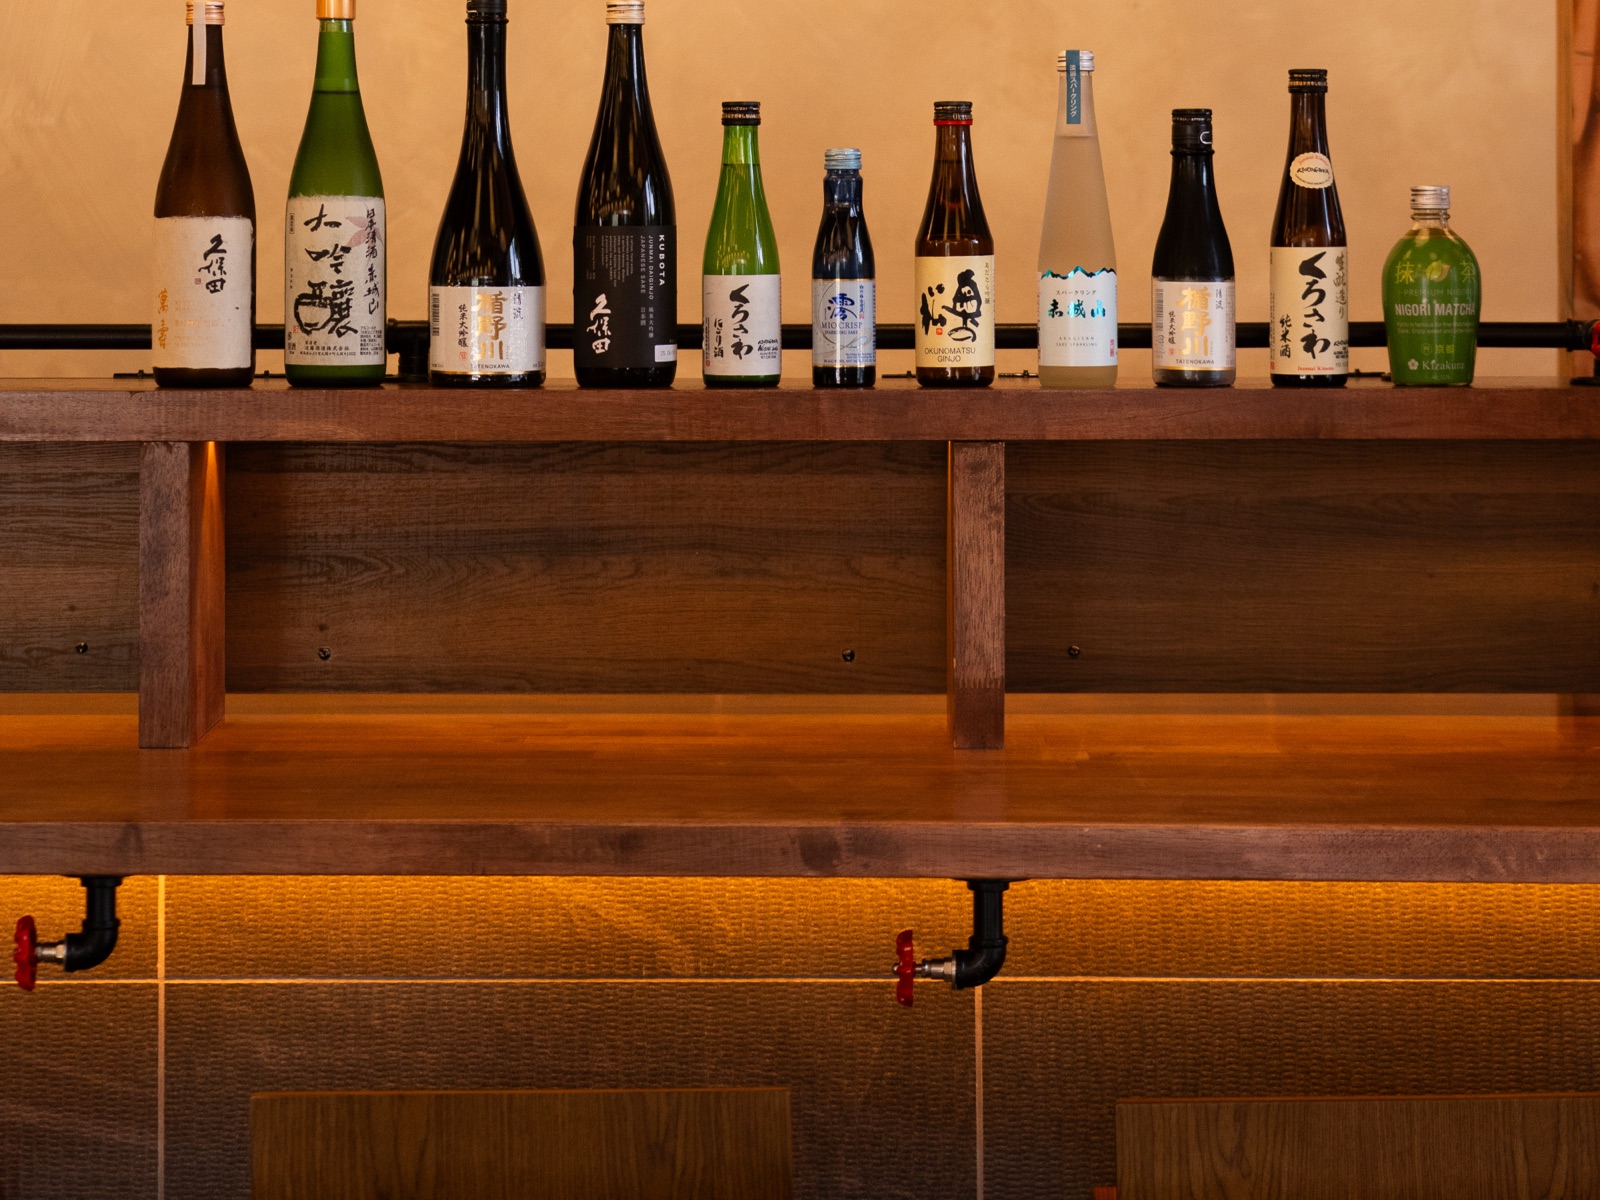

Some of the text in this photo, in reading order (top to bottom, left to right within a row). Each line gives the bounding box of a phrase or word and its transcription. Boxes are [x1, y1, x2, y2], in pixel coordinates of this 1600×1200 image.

[198, 233, 228, 294] 久保田
[729, 283, 754, 361] くろさわ
[827, 292, 858, 321] 澪
[1048, 298, 1106, 319] 赤城山
[1298, 251, 1331, 360] くろさわ
[1394, 303, 1475, 316] NIGORI MATCHA
[458, 303, 469, 348] 純米大吟醸
[586, 293, 612, 354] 久保田
[821, 321, 863, 329] MIO CRISP
[1168, 310, 1176, 345] 純米大吟醸
[1279, 313, 1292, 359] 純米酒
[924, 347, 976, 355] OKUNOMATSU
[1422, 360, 1465, 370] Kizakura
